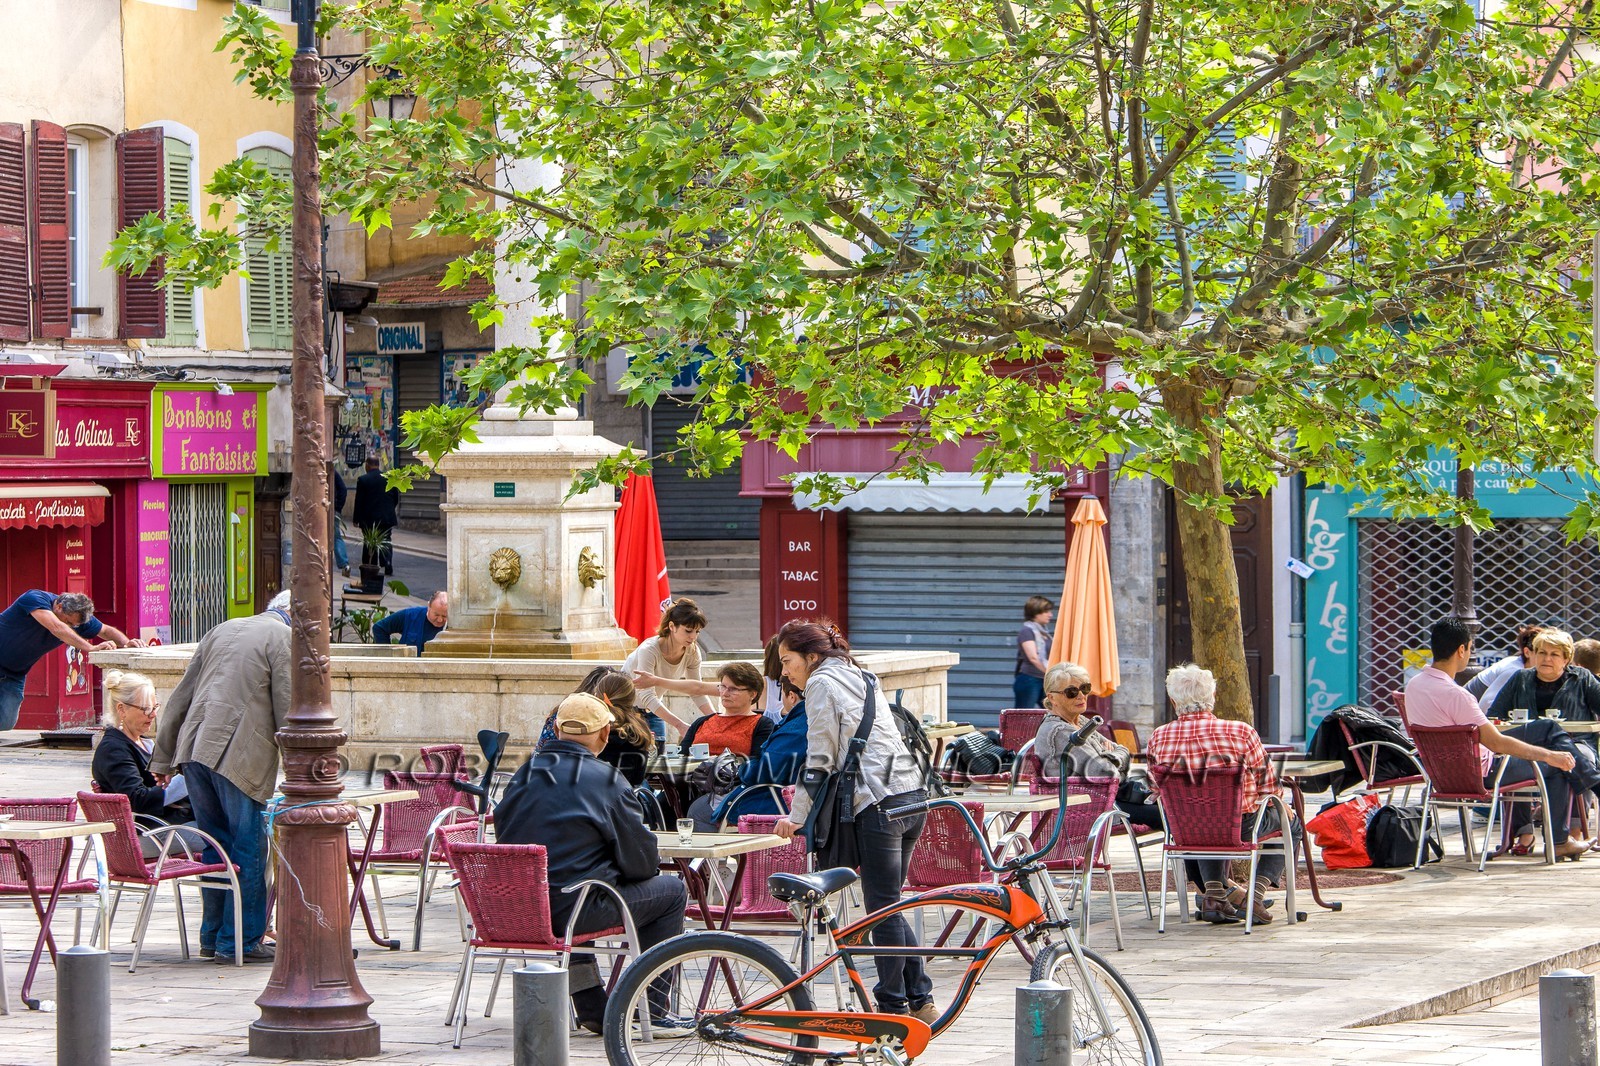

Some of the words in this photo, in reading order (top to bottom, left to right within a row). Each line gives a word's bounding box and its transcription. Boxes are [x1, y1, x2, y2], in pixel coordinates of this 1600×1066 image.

[378, 326, 423, 350] ORIGINAL
[164, 395, 232, 430] Bonbons
[242, 404, 257, 430] et
[75, 419, 114, 447] Délices
[181, 435, 257, 472] Fantaisies
[35, 500, 85, 522] Confiseries
[788, 541, 811, 551] BAR
[781, 570, 818, 581] TABAC
[784, 599, 817, 611] LOTO
